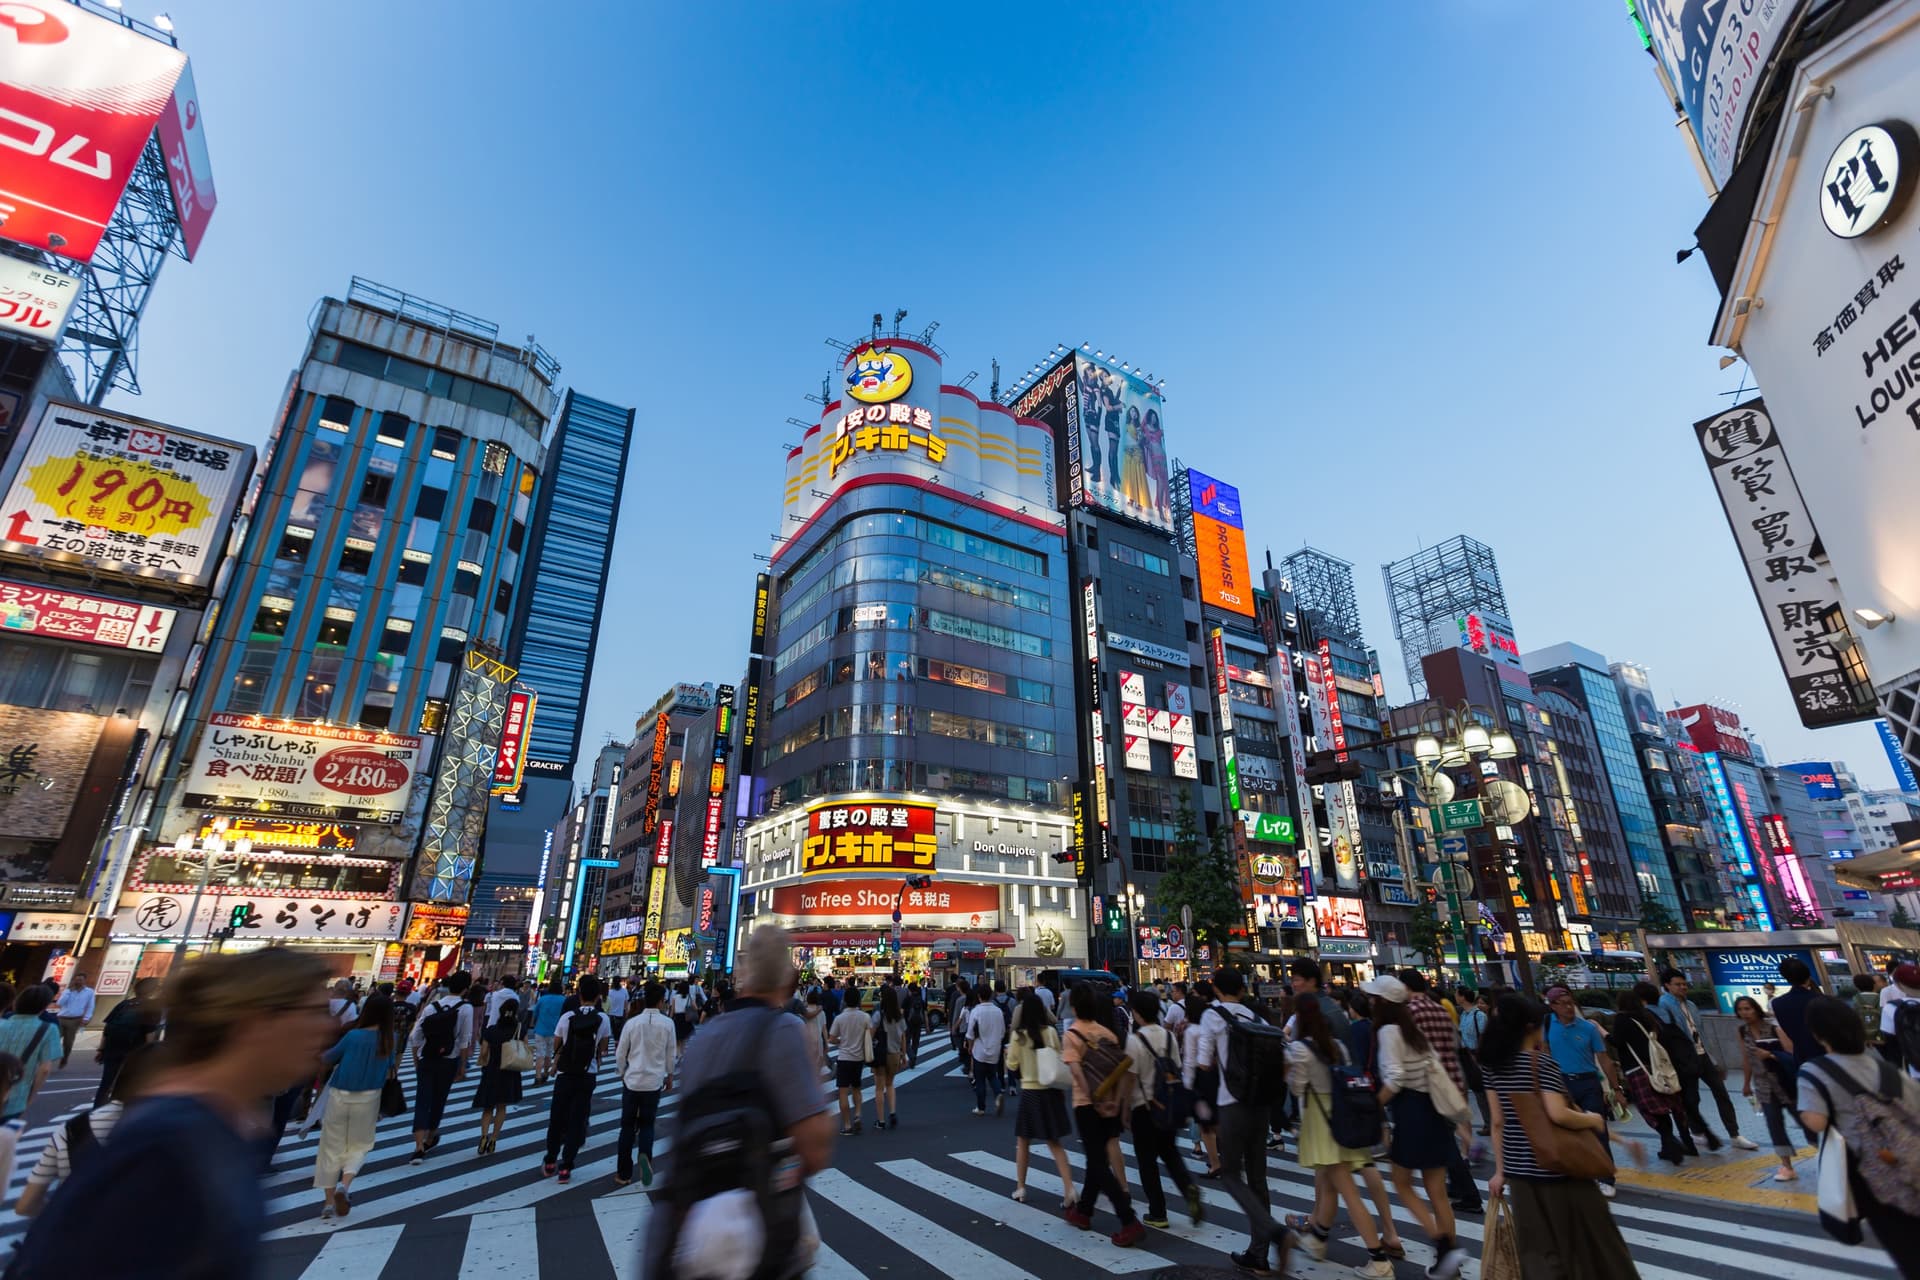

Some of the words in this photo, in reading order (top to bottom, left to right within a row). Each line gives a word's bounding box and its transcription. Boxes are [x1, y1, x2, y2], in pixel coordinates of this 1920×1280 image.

[1812, 254, 1905, 358] 高価買取
[55, 417, 230, 471] 一軒め酒場
[1709, 410, 1763, 458] 質
[57, 460, 195, 524] 190円
[44, 533, 182, 570] 左の路地を右へ
[1215, 523, 1234, 590] PROMISE
[99, 629, 126, 642] FREE
[103, 619, 129, 633] TAX
[136, 635, 160, 648] 1F
[1318, 645, 1335, 689] カラオケ
[213, 714, 313, 735] All-you-can-eat
[315, 726, 351, 740] buffet
[354, 731, 371, 742] for
[374, 734, 384, 744] 2
[386, 734, 418, 748] hours
[212, 730, 320, 755] しゃぶしゃぶ
[321, 762, 386, 788] 2,480
[530, 761, 564, 771] GRACERY
[1228, 772, 1237, 794] レイク
[291, 805, 337, 818] USAGIYA
[378, 811, 402, 824] 5F
[818, 807, 909, 830] 驚安の殿堂
[1262, 818, 1291, 837] レイク
[762, 852, 771, 863] Don
[773, 847, 791, 862] Quijote
[974, 841, 995, 853] Don
[998, 843, 1036, 858] Quijote
[700, 888, 713, 931] カラオケ
[801, 893, 817, 909] Tax
[820, 892, 852, 907] Free
[857, 889, 903, 909] Shop
[909, 891, 950, 908] 免税店
[138, 896, 174, 929] 虎
[833, 938, 848, 946] Don
[849, 938, 877, 947] Quijote
[103, 976, 126, 987] OK!
